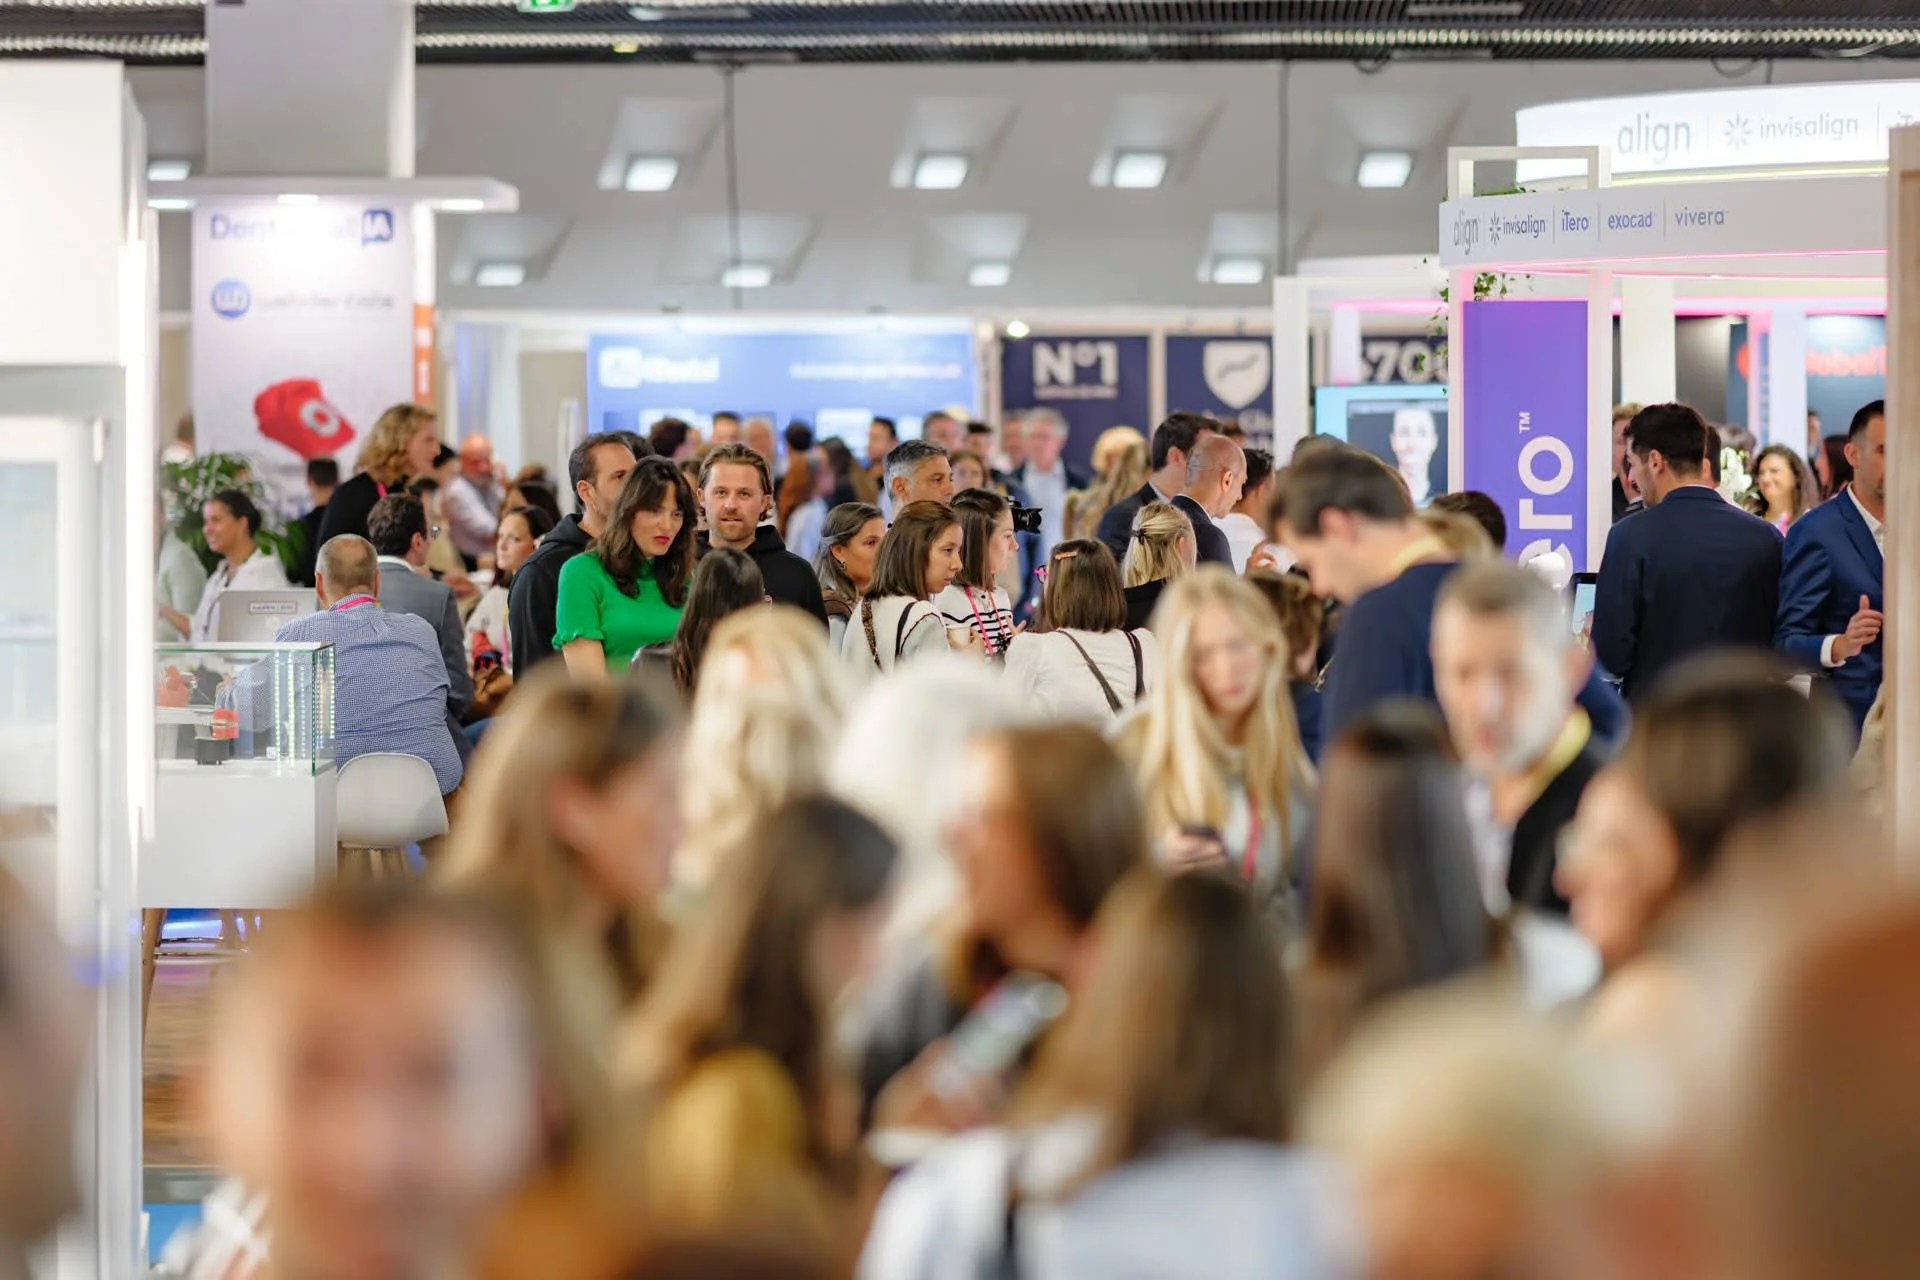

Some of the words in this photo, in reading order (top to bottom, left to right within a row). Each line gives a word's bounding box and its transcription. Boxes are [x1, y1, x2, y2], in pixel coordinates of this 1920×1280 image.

[1618, 111, 1691, 164] align
[1760, 113, 1858, 141] invisalign
[1453, 209, 1479, 256] align
[1503, 214, 1547, 239] invisalign
[1562, 209, 1590, 231] iTero
[1607, 211, 1654, 230] exocad
[1674, 206, 1726, 226] vivera
